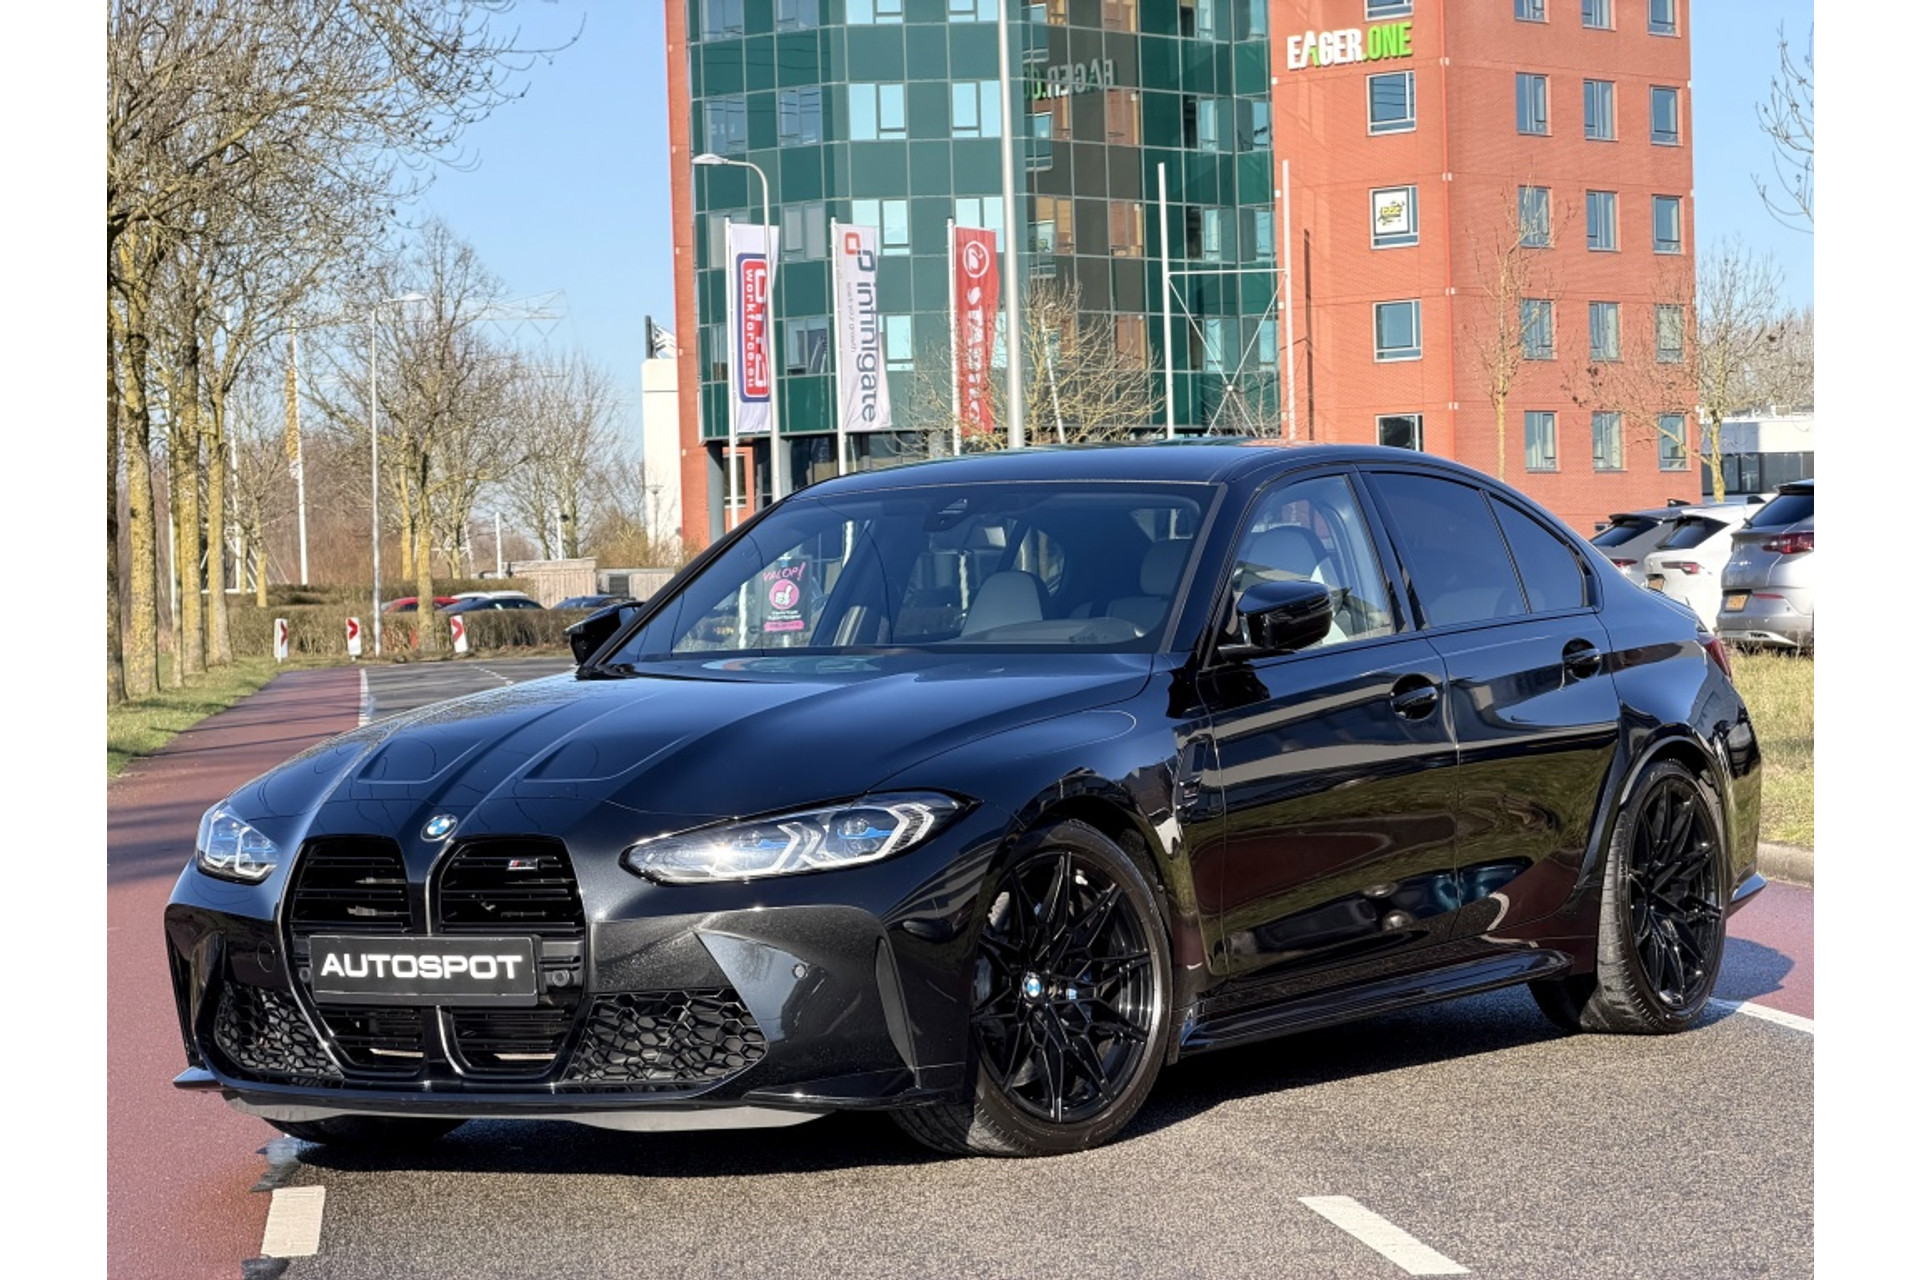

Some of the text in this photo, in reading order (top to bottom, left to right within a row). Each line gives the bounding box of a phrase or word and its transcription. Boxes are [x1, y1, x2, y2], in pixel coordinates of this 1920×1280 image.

[1287, 22, 1412, 69] EAGER.ONE
[745, 269, 755, 388] workforce.eu
[857, 282, 878, 423] infinigate
[321, 953, 522, 979] AUTOSPOT
